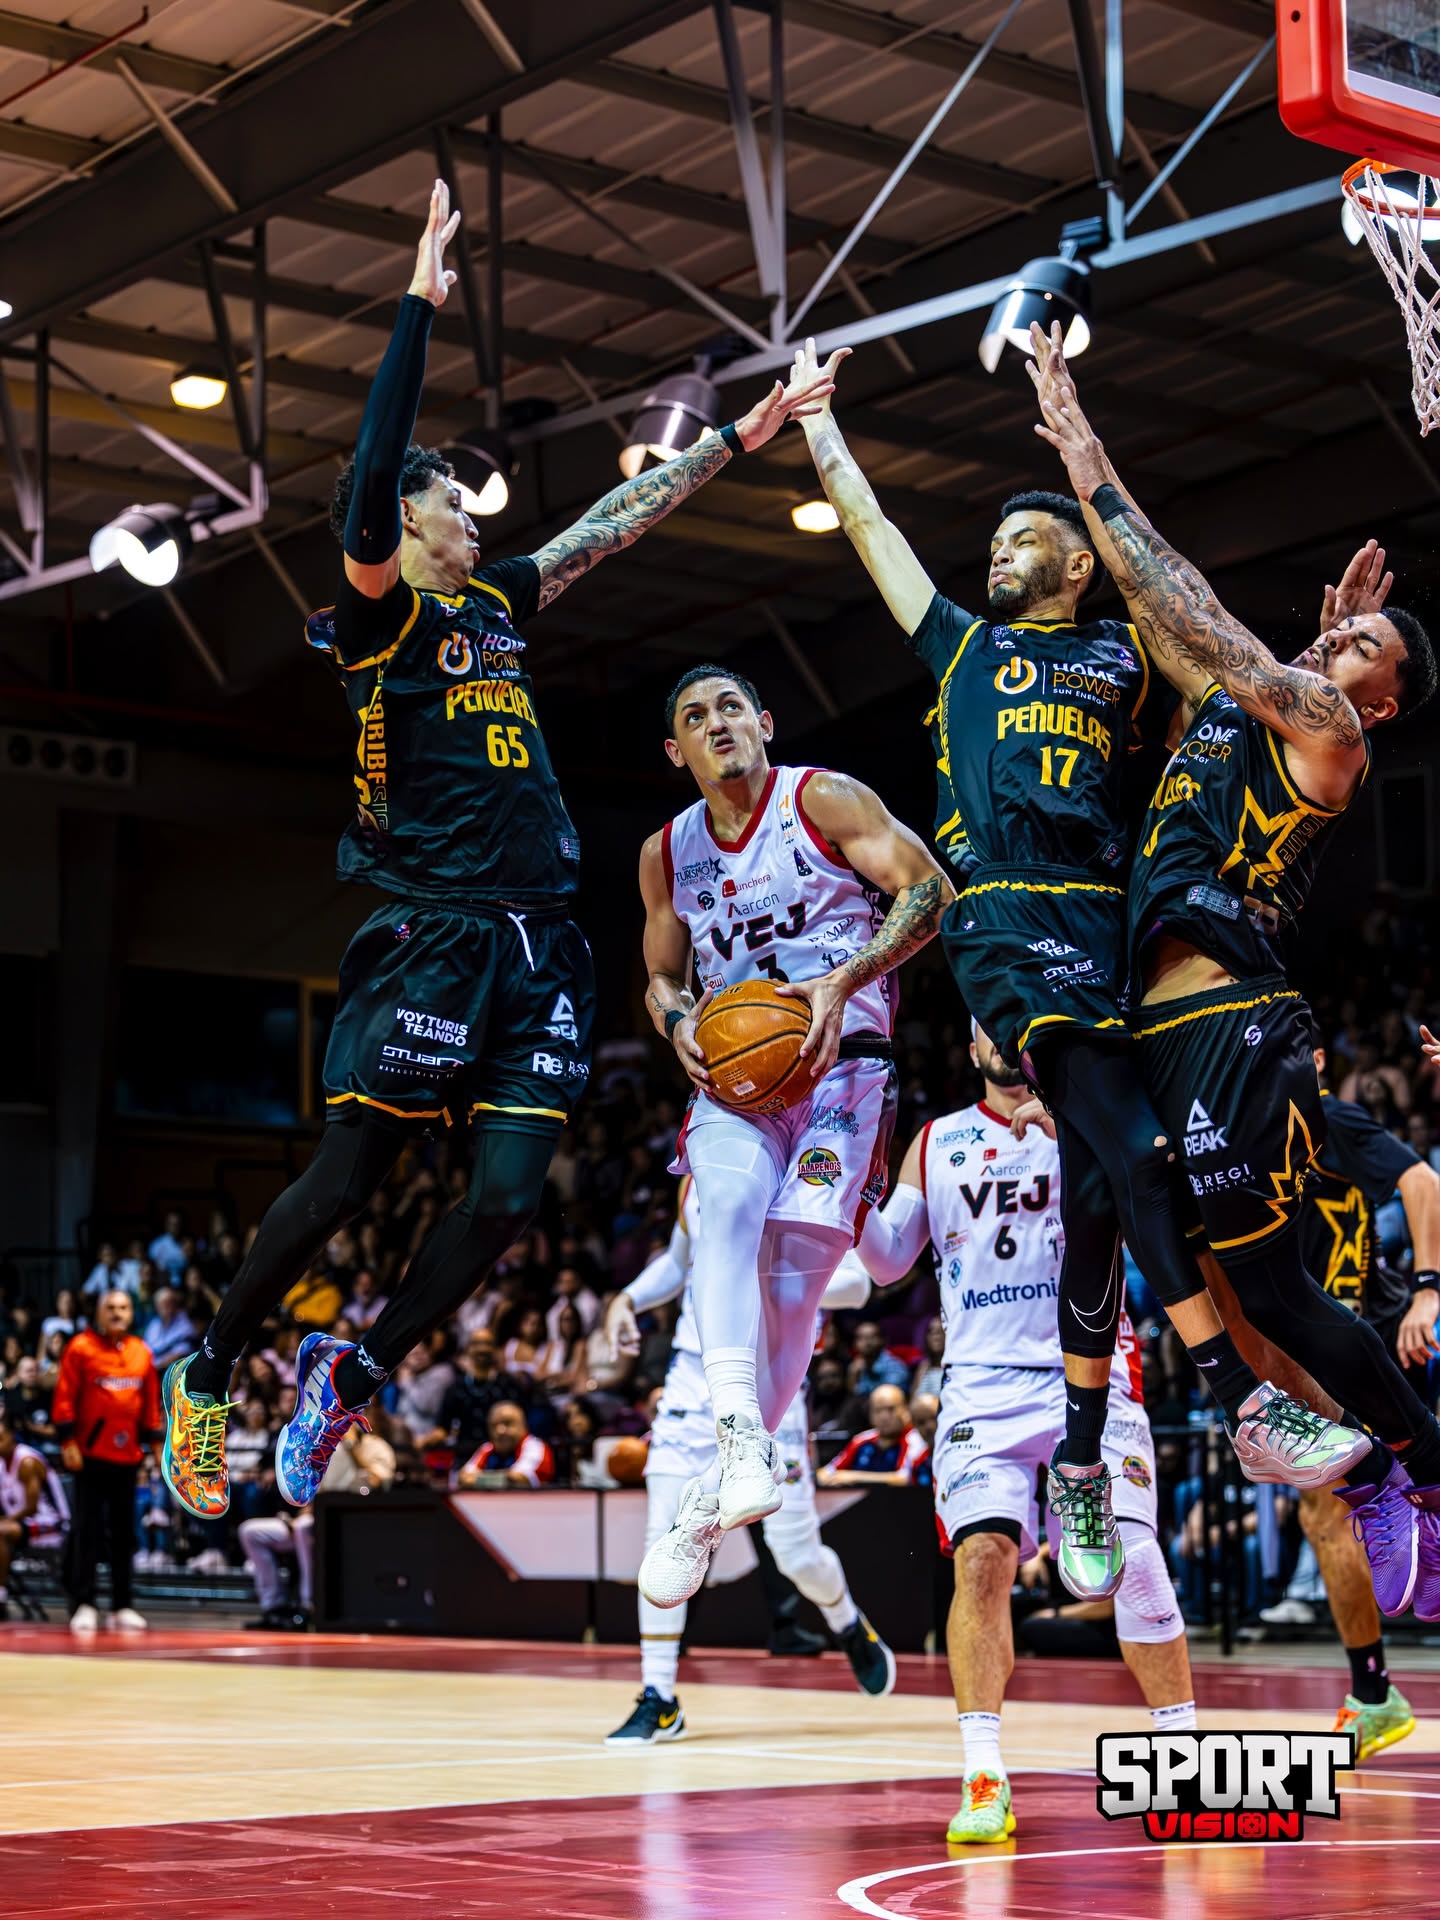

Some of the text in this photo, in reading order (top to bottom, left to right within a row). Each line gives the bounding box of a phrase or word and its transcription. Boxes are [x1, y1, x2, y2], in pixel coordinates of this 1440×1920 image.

[1052, 662, 1118, 686] HOME
[1053, 672, 1121, 709] POWER
[1075, 691, 1107, 707] ENERGY
[486, 724, 530, 769] 65
[997, 701, 1112, 763] PEÑUELAS
[1039, 745, 1080, 788] 17
[710, 901, 806, 961] VEJ
[755, 952, 790, 984] 3
[404, 1022, 467, 1047] TEANDO
[1183, 1126, 1229, 1157] PEAK
[959, 1174, 1051, 1219] VEJ
[993, 1224, 1018, 1260] 6
[960, 1277, 1059, 1312] Medtroni
